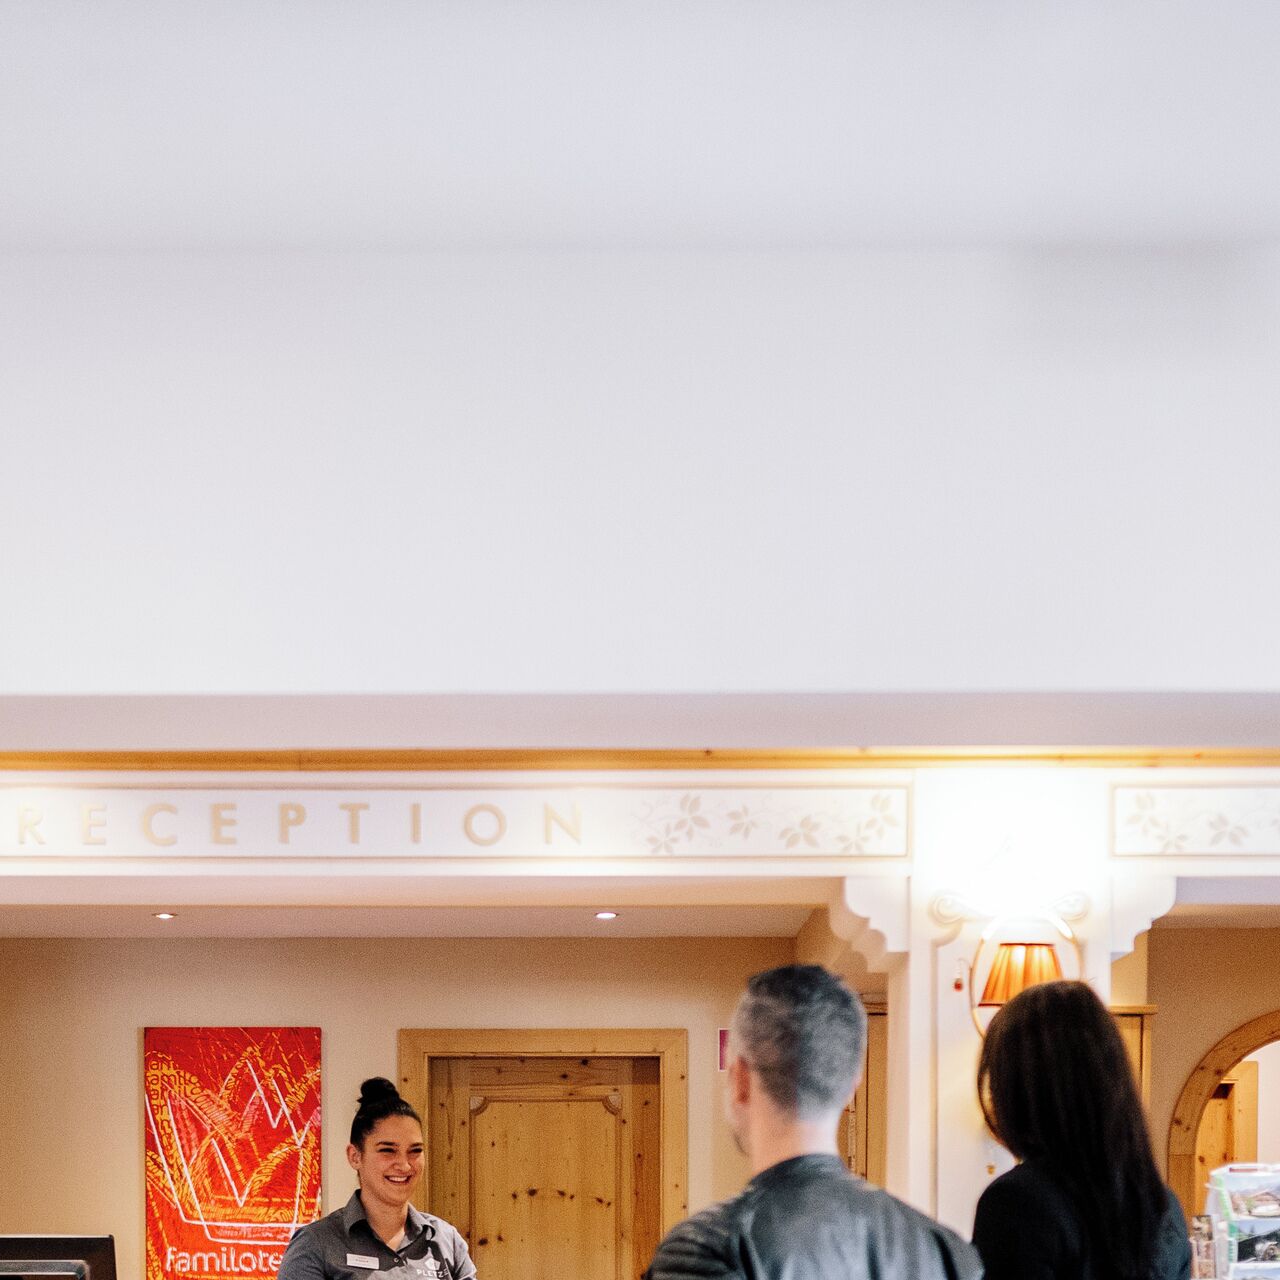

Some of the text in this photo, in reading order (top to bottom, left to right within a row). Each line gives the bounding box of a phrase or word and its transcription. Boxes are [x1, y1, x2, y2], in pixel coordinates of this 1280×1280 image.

[16, 801, 584, 847] RECEPTION
[165, 1246, 282, 1273] familote
[416, 1268, 449, 1278] PLETZE
